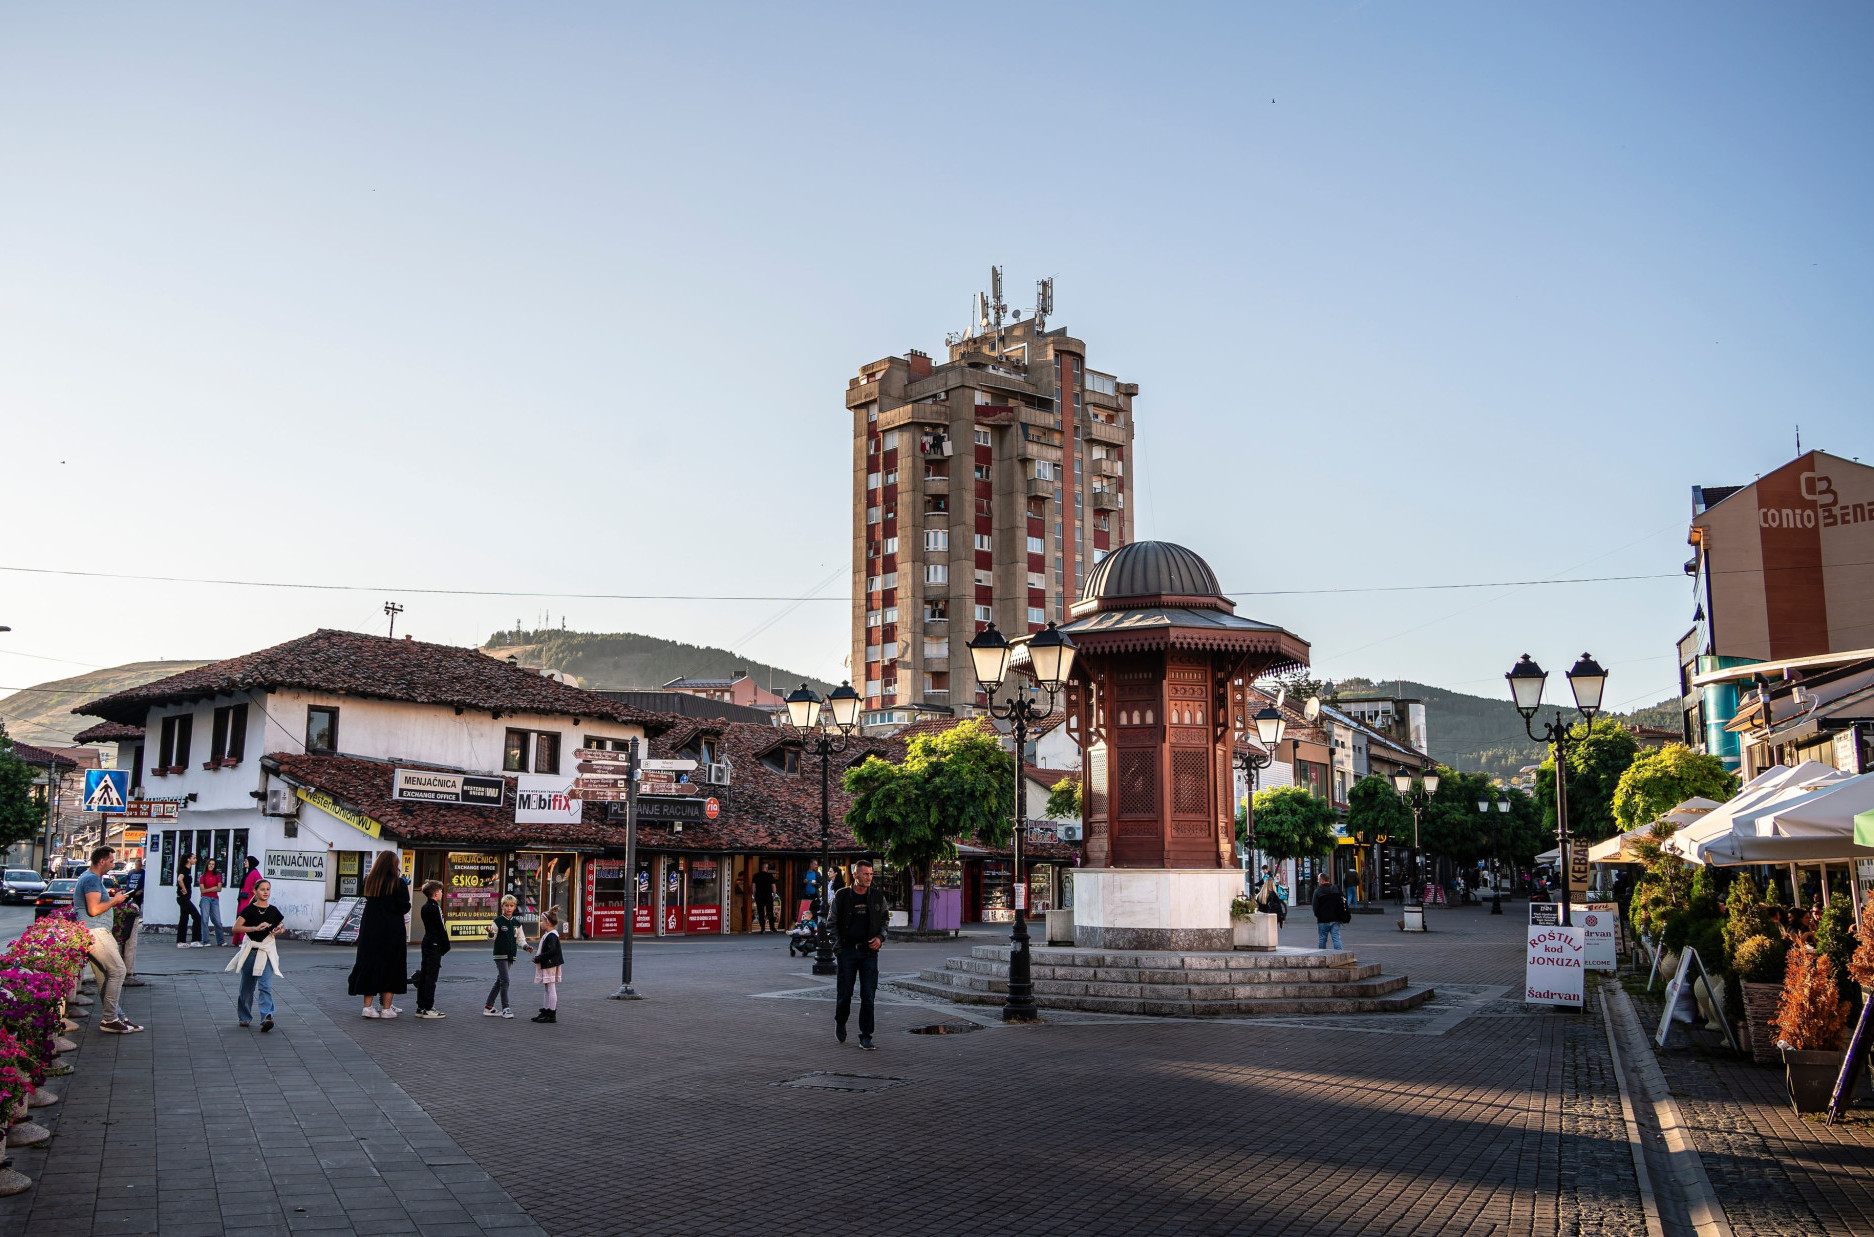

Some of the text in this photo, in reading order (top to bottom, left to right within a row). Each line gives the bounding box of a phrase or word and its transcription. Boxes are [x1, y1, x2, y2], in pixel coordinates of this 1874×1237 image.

[404, 775, 457, 789] MENJAČNICA
[402, 790, 435, 799] EXCHANGE
[611, 802, 661, 816] PLAANJE
[267, 852, 324, 868] MENJAČNICA
[1571, 838, 1589, 884] KEBAB
[1529, 929, 1583, 952] ROŠTILJ
[1544, 944, 1563, 954] kod
[1529, 956, 1581, 968] JONUZA
[1527, 986, 1581, 1002] Šadrvan
